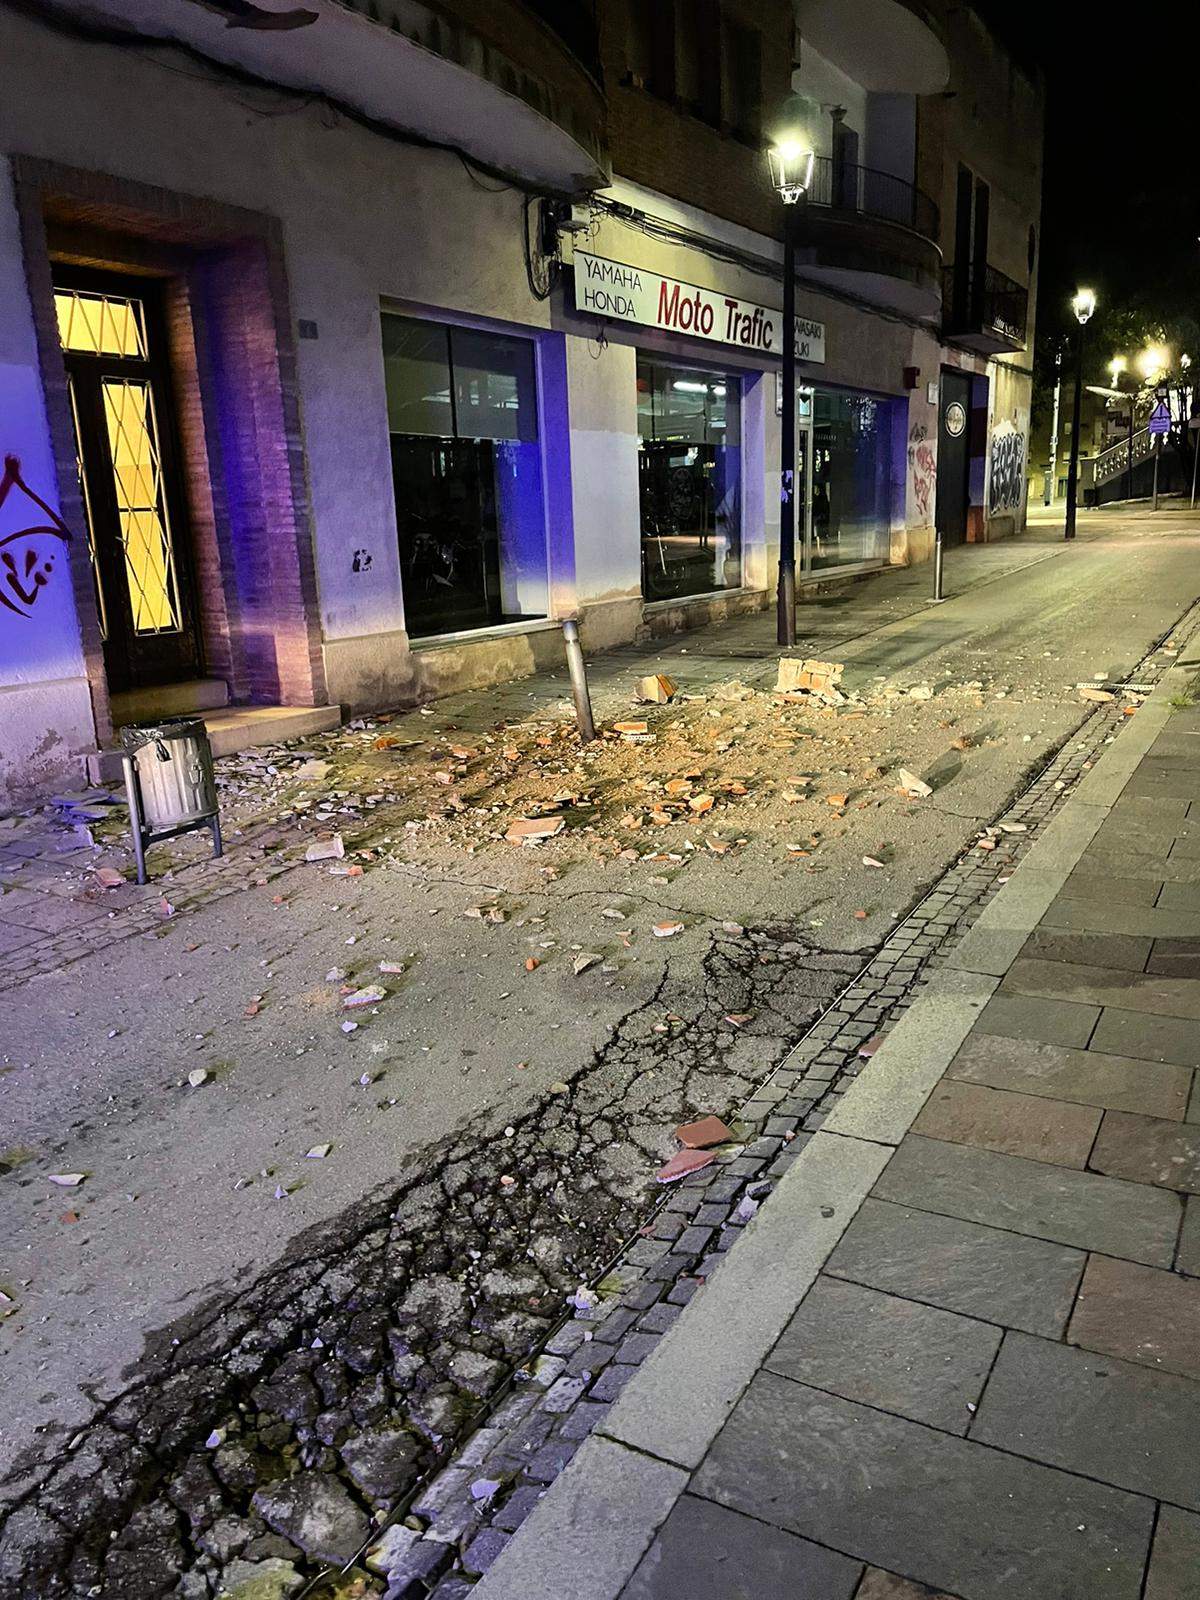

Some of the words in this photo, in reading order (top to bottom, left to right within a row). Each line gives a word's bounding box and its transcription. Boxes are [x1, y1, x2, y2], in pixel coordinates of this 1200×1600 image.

[584, 257, 642, 292] YAMAHA
[584, 287, 636, 318] HONDA
[658, 280, 714, 335] Moto
[725, 298, 773, 349] Trafic
